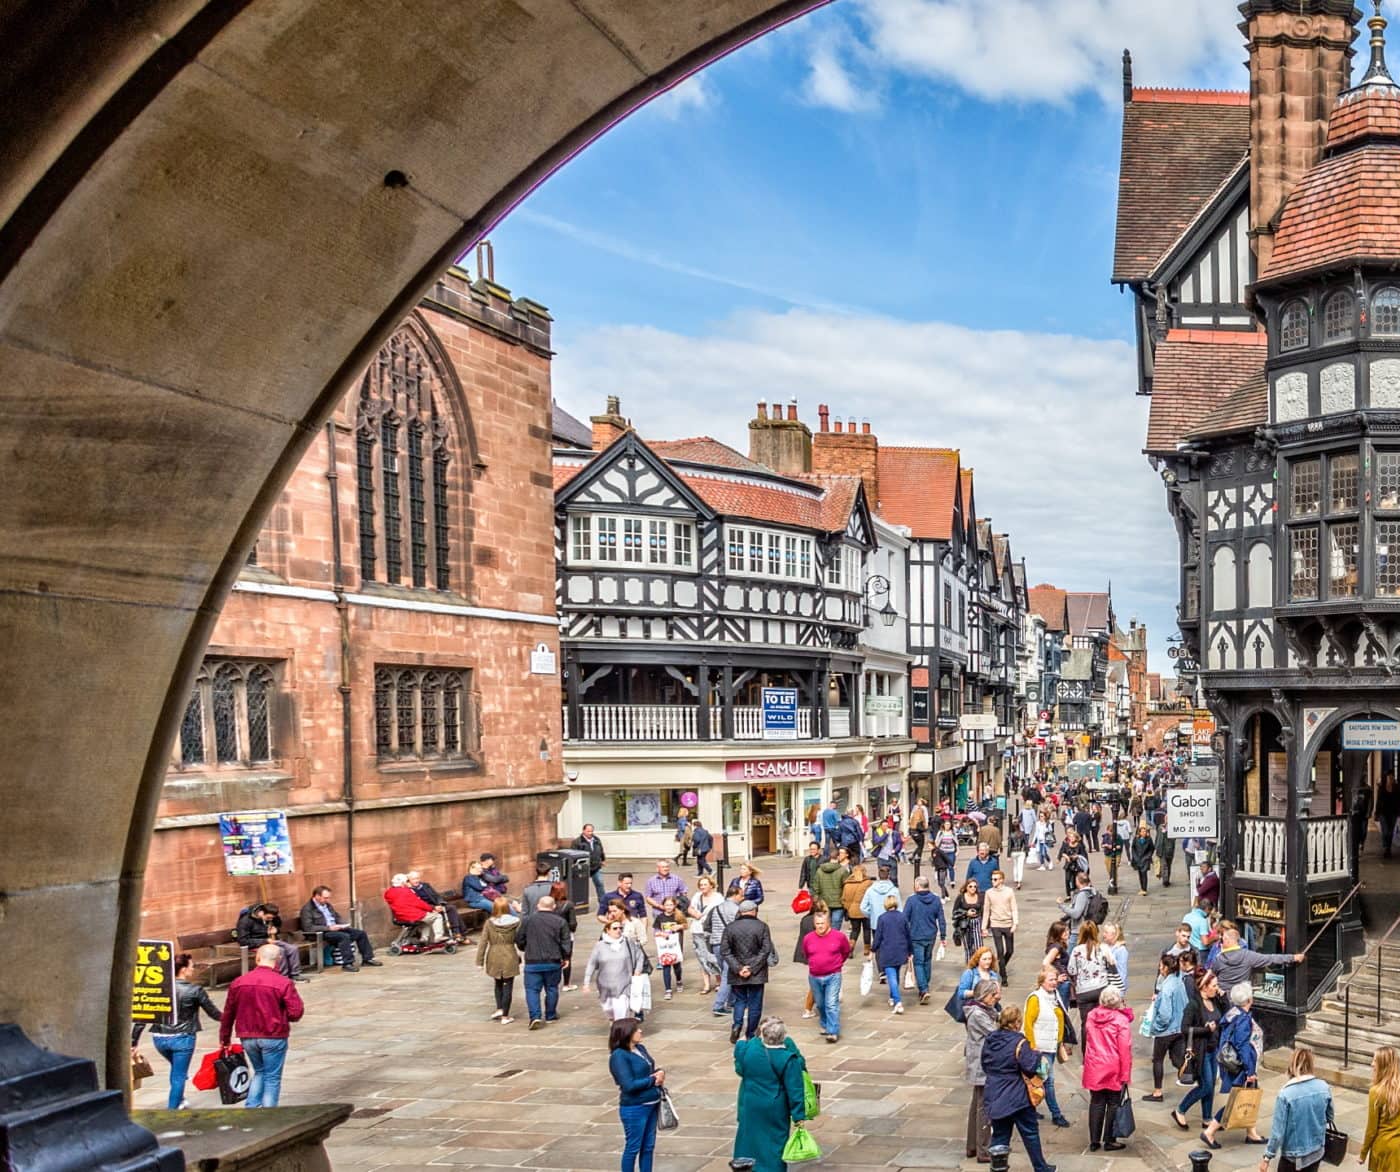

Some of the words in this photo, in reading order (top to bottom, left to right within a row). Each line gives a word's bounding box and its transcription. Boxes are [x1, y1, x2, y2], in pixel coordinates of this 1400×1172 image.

[765, 695, 778, 704] TO
[780, 695, 795, 704] LET
[757, 760, 816, 777] SAMUEL
[1171, 795, 1212, 808] Gabor
[1243, 898, 1281, 919] Waltons
[234, 1071, 249, 1089] JD
